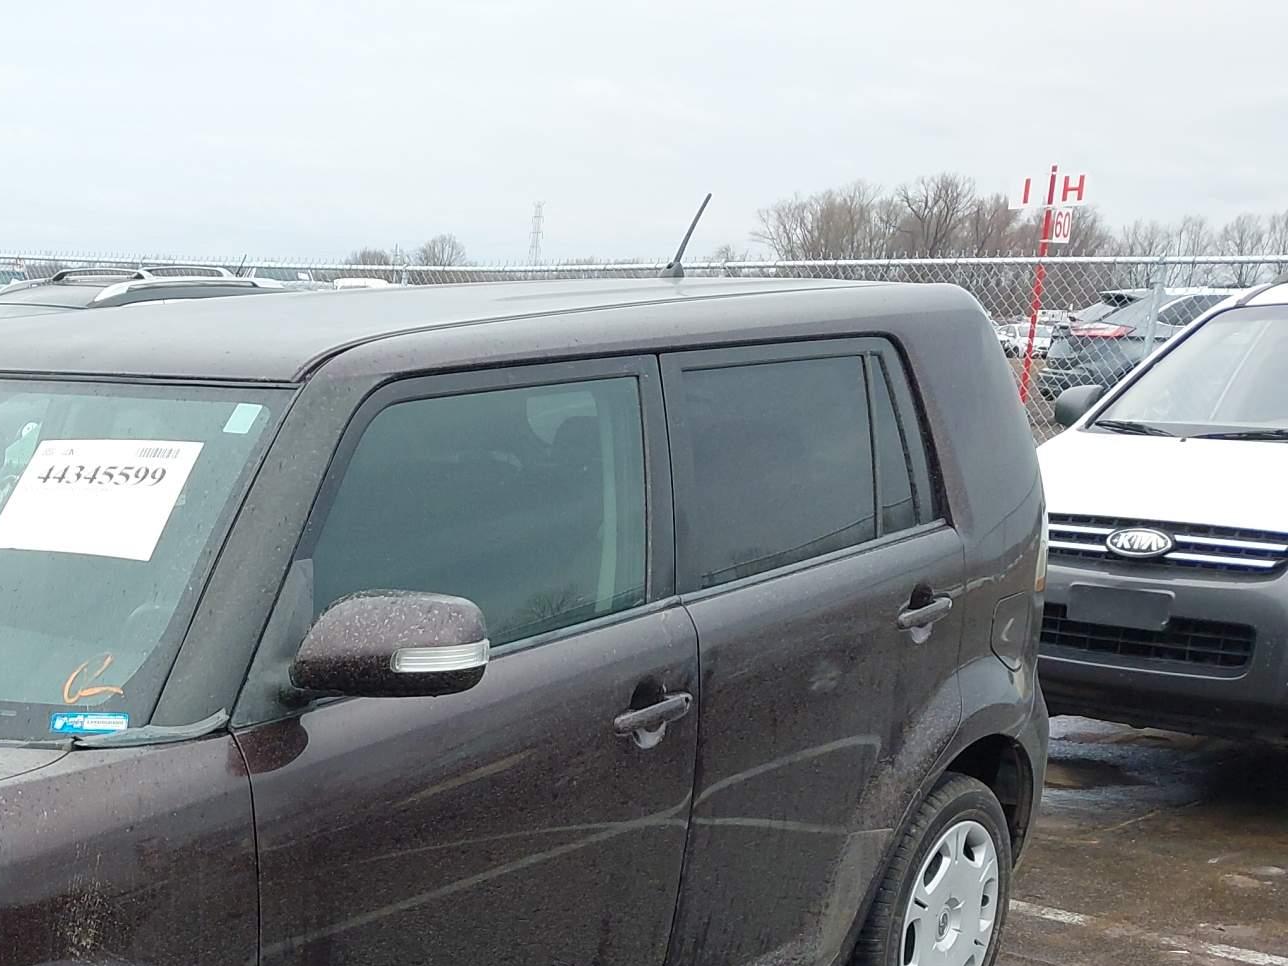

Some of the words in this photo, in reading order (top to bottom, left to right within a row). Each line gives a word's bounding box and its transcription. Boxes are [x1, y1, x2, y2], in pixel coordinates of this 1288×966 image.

[1062, 174, 1086, 202] H
[1054, 211, 1071, 238] 60
[37, 464, 167, 487] 44345599
[1115, 532, 1168, 551] KIA
